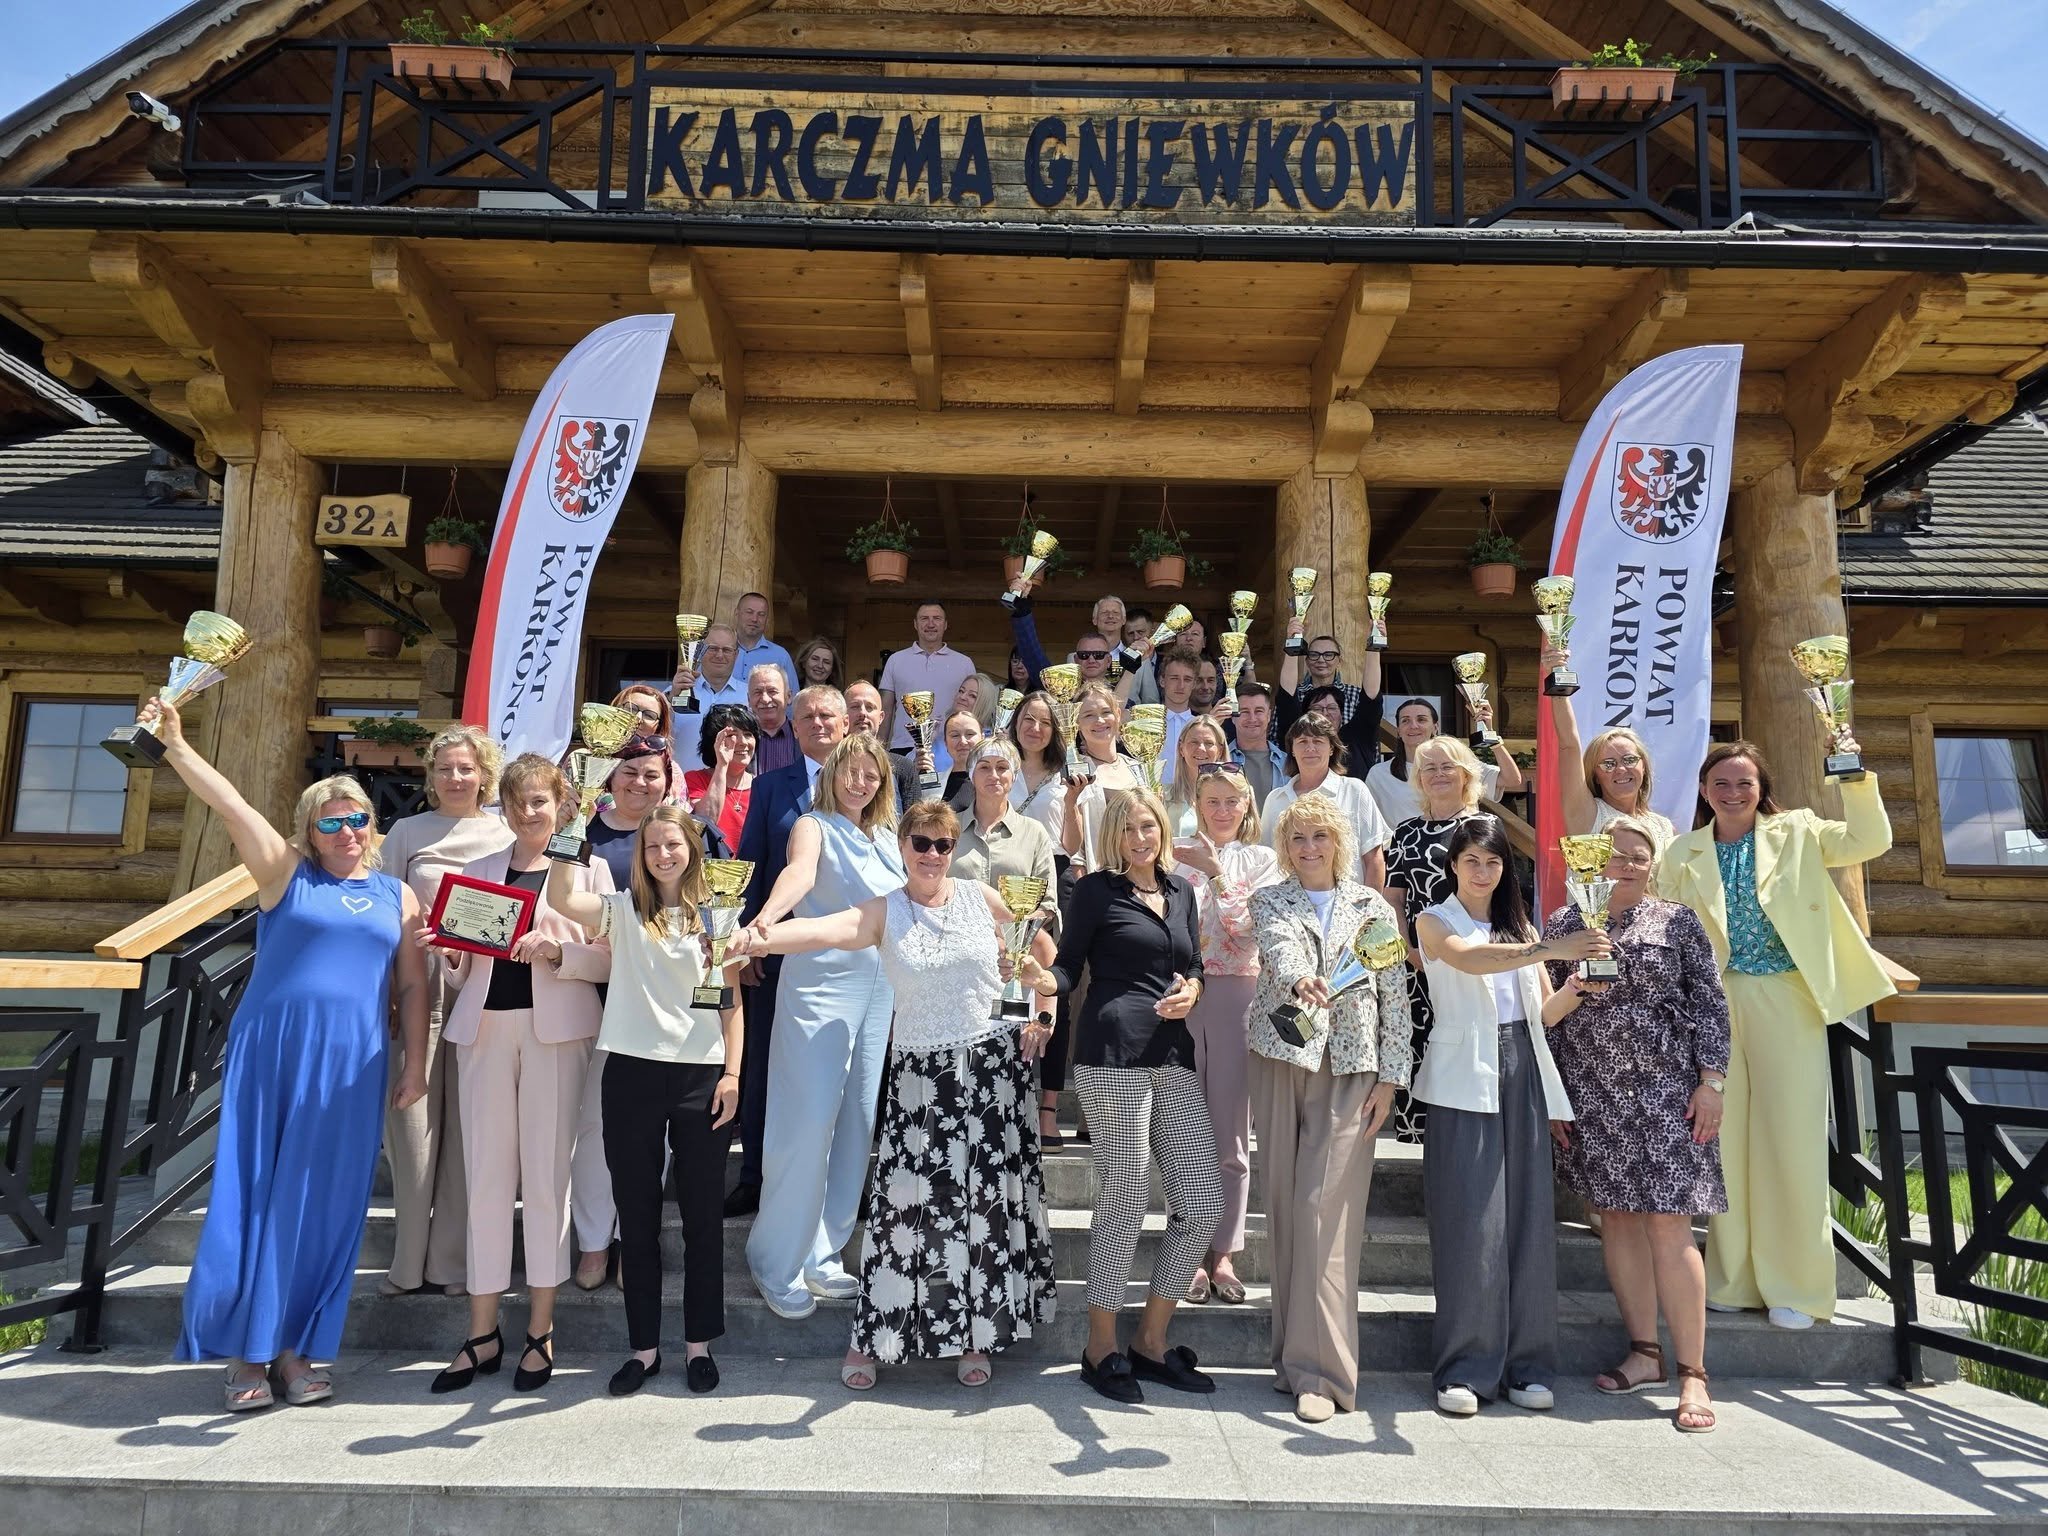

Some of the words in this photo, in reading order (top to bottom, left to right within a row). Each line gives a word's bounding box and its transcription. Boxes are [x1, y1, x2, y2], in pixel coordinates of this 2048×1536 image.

[648, 106, 995, 207] KARCZMA
[1025, 103, 1416, 211] GNIEWKÓW
[530, 543, 595, 703] POWIAT
[1645, 566, 1689, 726] POWIAT
